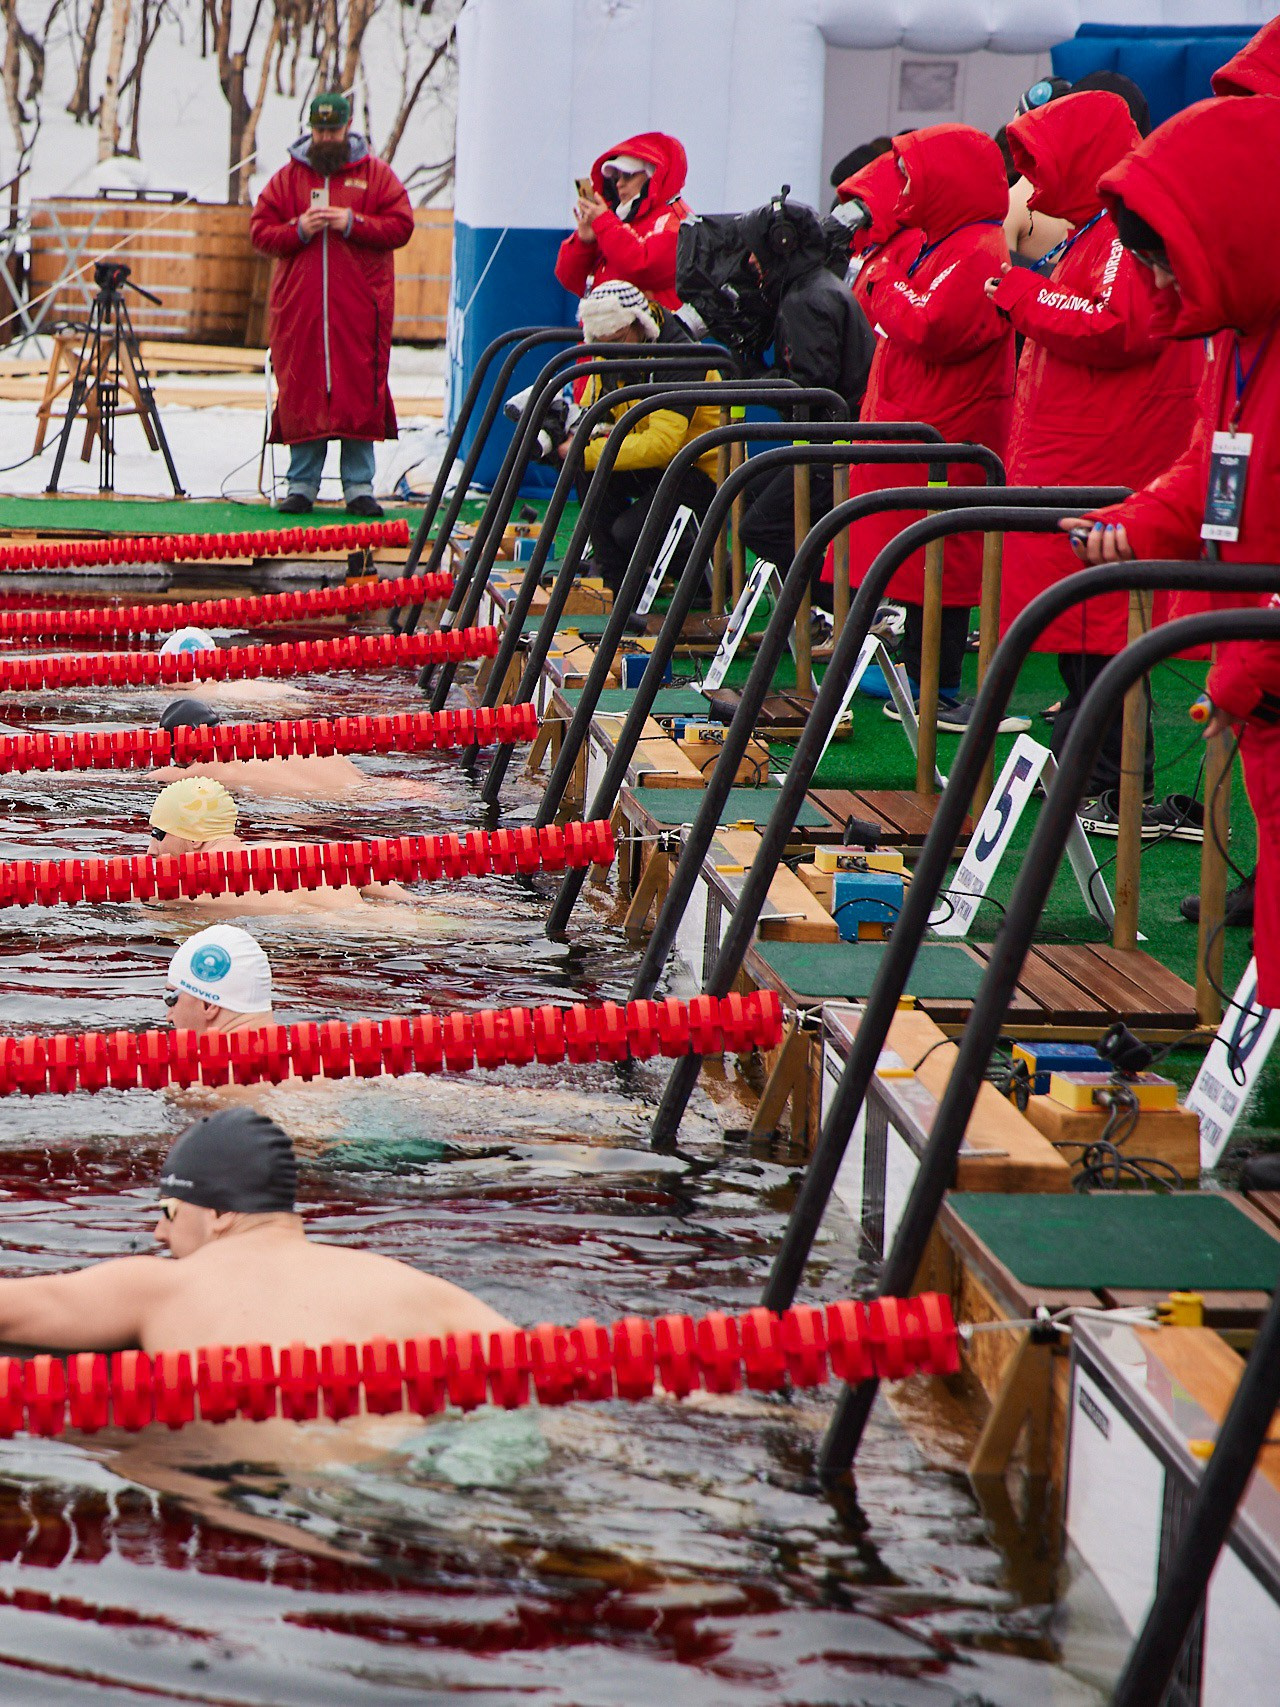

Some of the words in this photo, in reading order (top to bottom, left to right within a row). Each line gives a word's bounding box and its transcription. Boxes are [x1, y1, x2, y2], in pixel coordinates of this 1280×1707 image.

[653, 517, 682, 580] 2
[975, 755, 1034, 862] 5
[179, 979, 221, 1001] BROVKO
